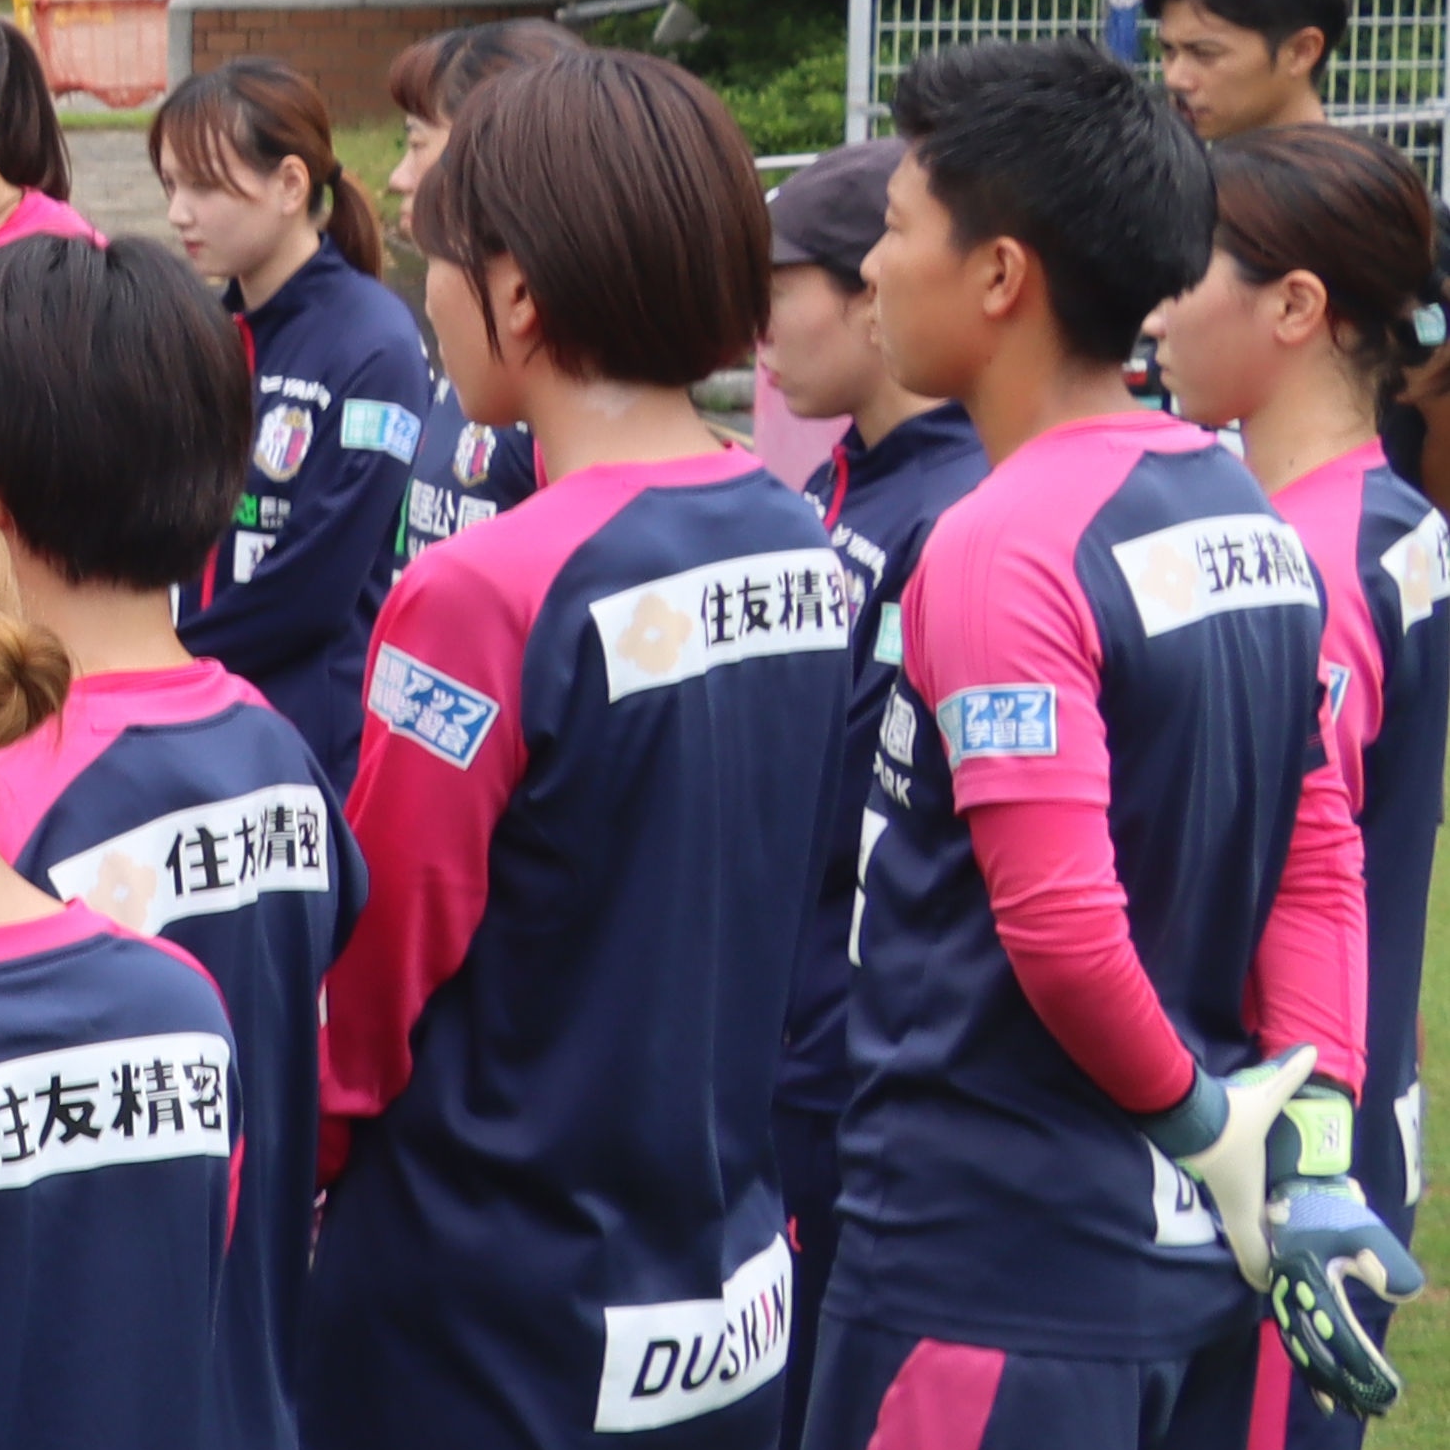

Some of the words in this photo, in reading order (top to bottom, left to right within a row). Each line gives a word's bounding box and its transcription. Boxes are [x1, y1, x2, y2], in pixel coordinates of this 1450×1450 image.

[965, 690, 1046, 720] アップ
[965, 719, 1045, 747] 学習会
